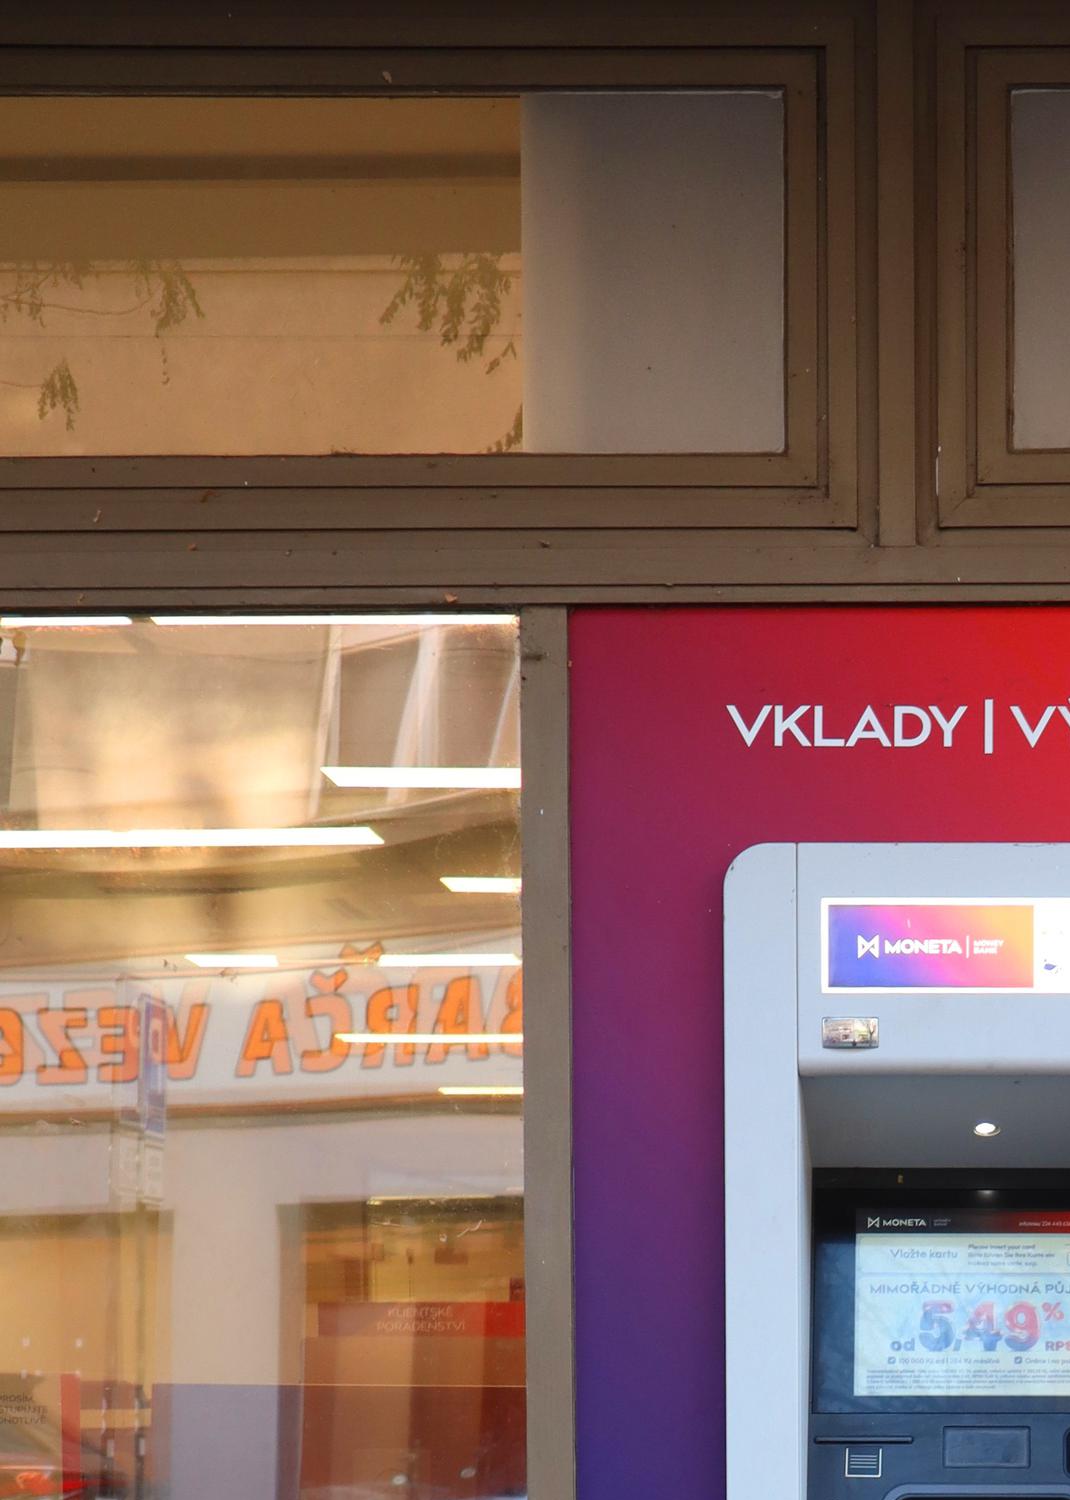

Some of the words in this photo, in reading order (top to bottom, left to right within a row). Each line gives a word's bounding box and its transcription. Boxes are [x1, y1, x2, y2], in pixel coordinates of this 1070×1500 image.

[726, 704, 968, 748] VKLADY
[884, 938, 962, 956] MONETA
[882, 1218, 927, 1227] MONETA
[889, 1248, 927, 1259] Vložte
[929, 1248, 958, 1259] kartu
[966, 1281, 1041, 1295] VÝHODNÁ
[890, 1337, 916, 1352] od
